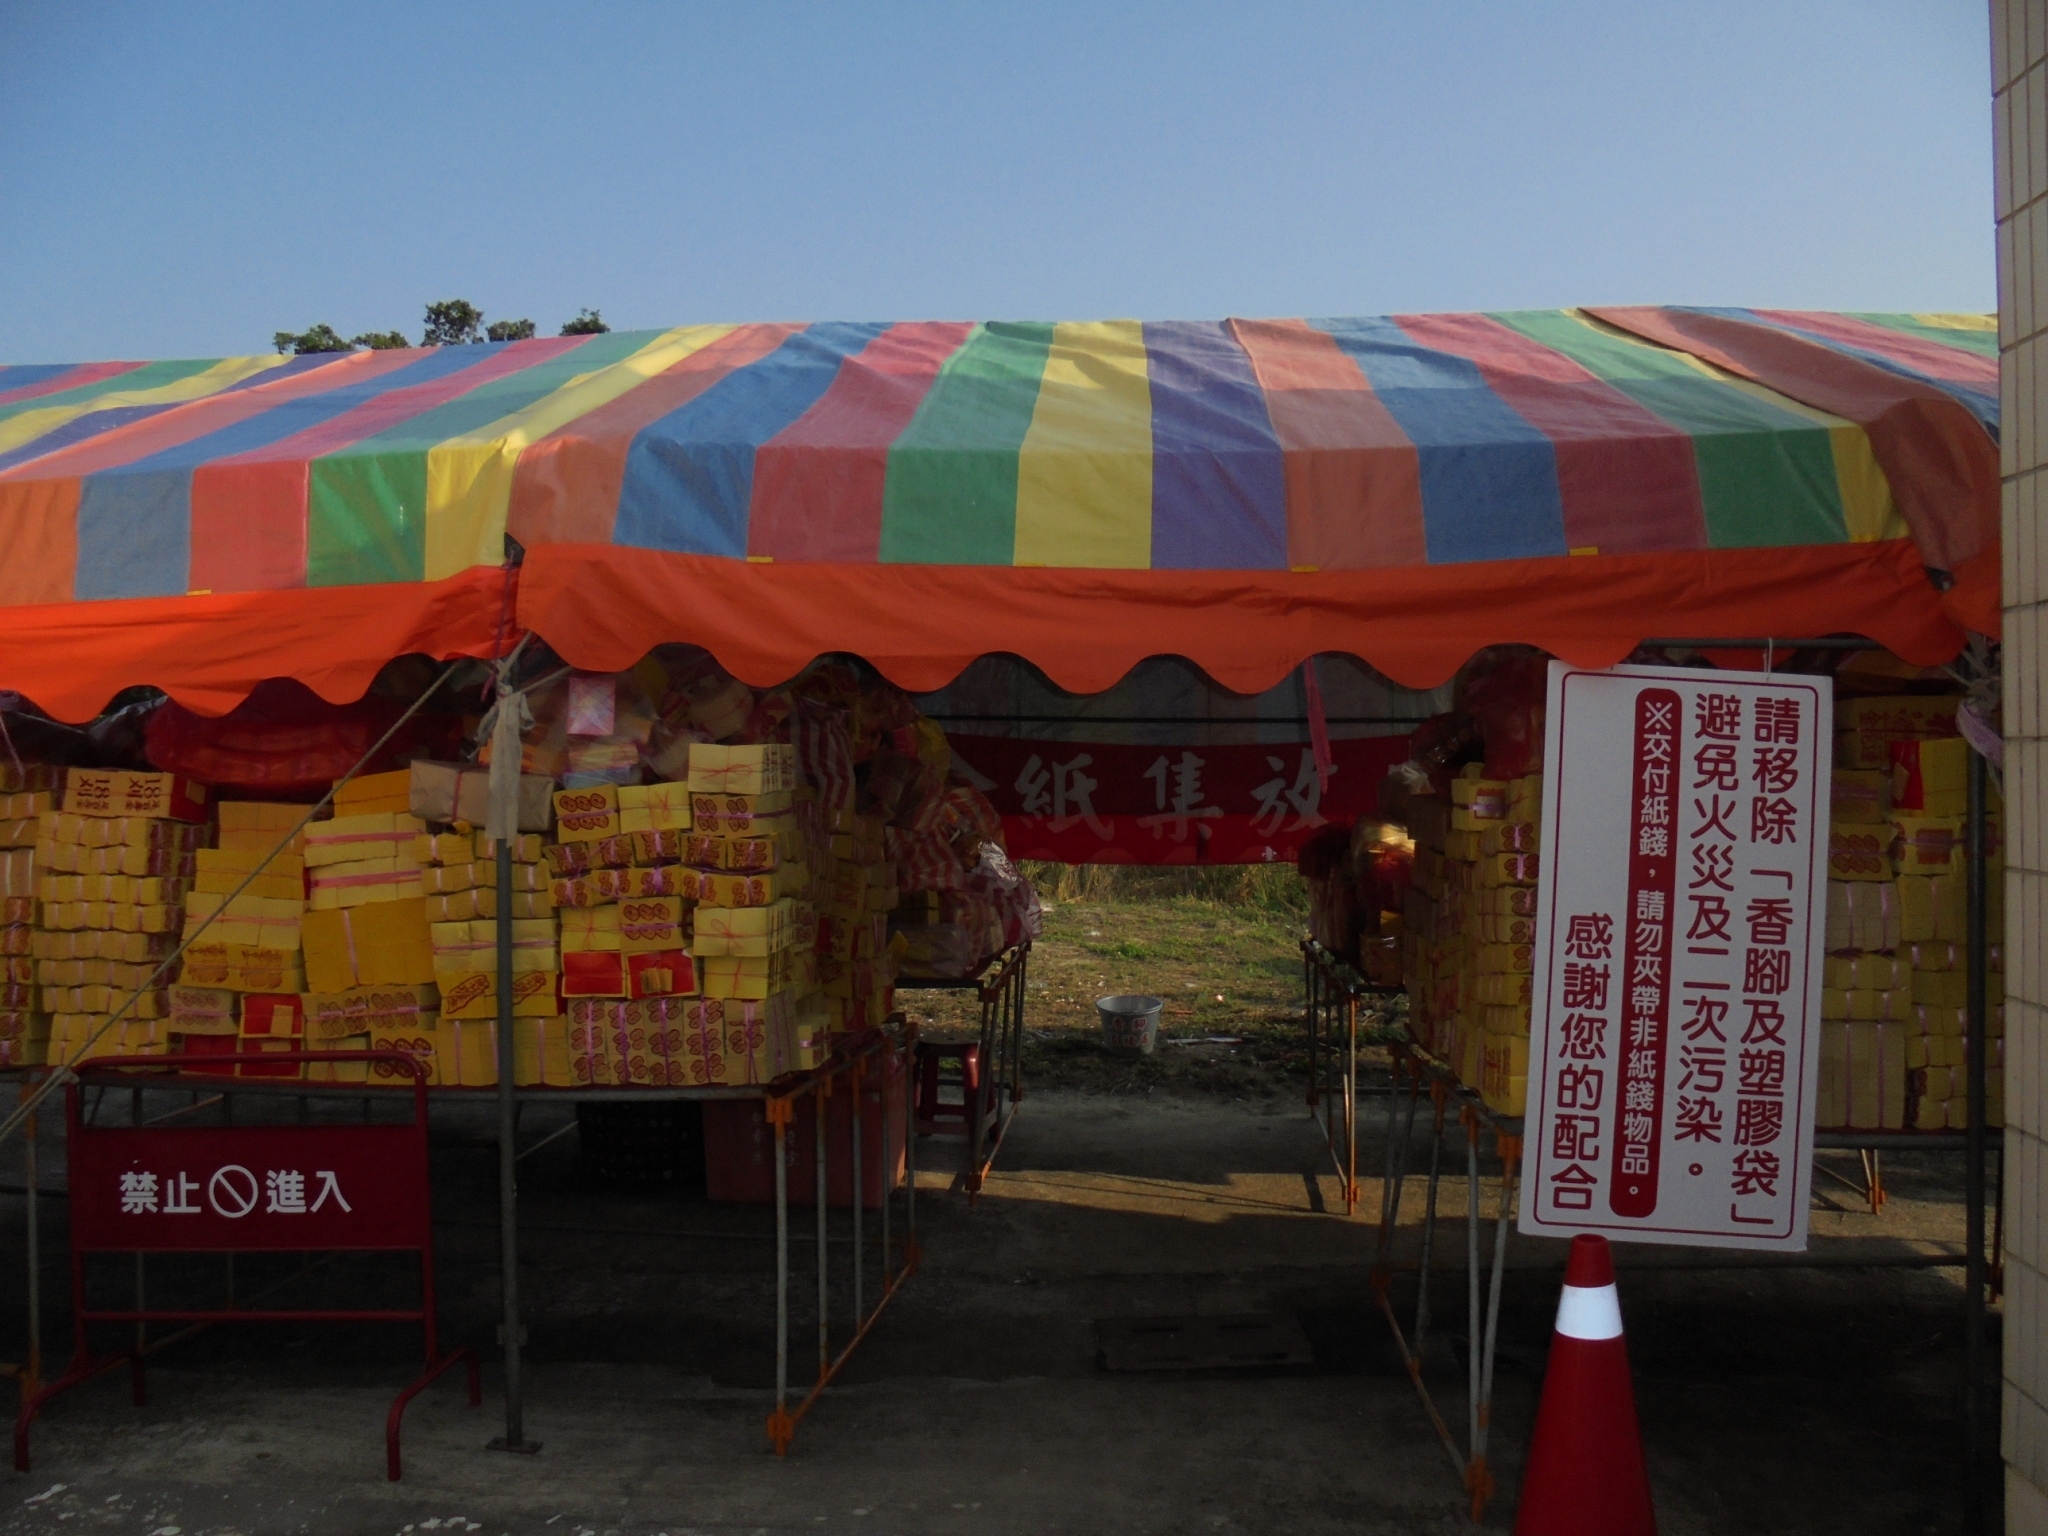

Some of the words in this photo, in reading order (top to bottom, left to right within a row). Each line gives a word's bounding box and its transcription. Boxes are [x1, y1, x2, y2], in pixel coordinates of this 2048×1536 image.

[1550, 912, 1614, 1212] 感謝您的配合
[1675, 693, 1742, 1177] 避免火災及二次污染。
[1732, 697, 1801, 1226] 請移除「香腳及塑膠袋」
[120, 1171, 202, 1215] 禁止
[266, 1169, 353, 1215] 進入
